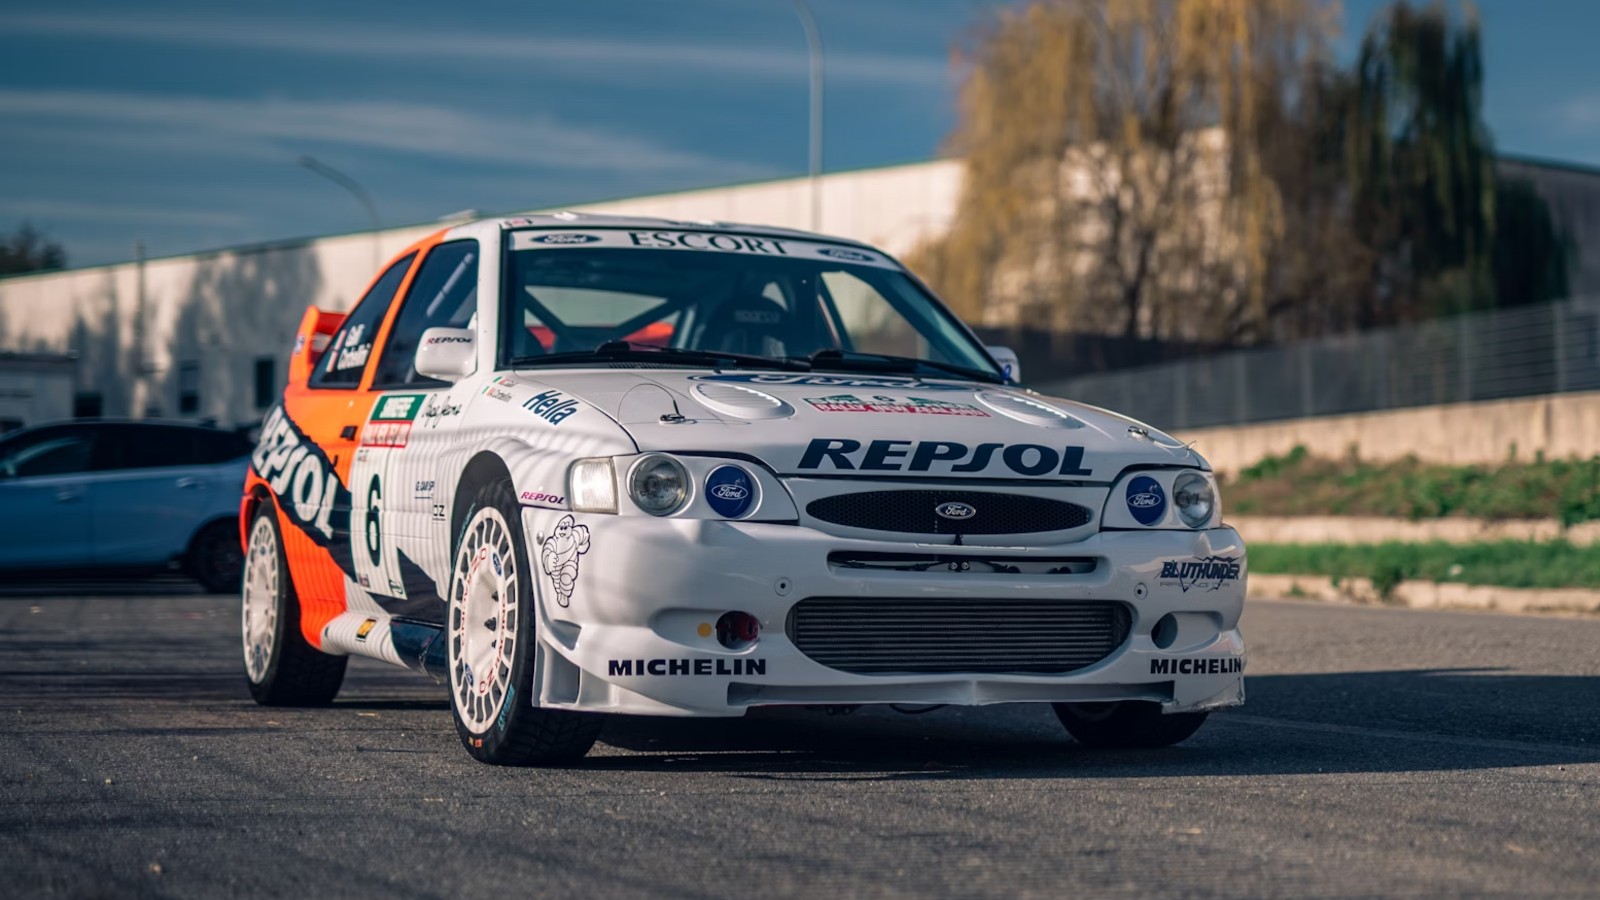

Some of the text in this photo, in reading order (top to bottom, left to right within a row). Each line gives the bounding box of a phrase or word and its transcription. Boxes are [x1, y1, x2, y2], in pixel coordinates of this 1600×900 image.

[543, 233, 588, 244] Ford
[628, 231, 788, 255] ESCORT
[522, 389, 580, 426] Hella
[797, 437, 1093, 477] REPSOL
[252, 404, 338, 540] REPSOL
[521, 491, 566, 505] REPSOL
[718, 485, 743, 498] Ford
[1133, 494, 1156, 506] Ford
[944, 503, 969, 516] Ford
[365, 473, 382, 567] 6
[1160, 560, 1240, 580] BLUTHUNDER
[608, 659, 766, 676] MICHELIN
[1150, 657, 1242, 674] MICHELIN
